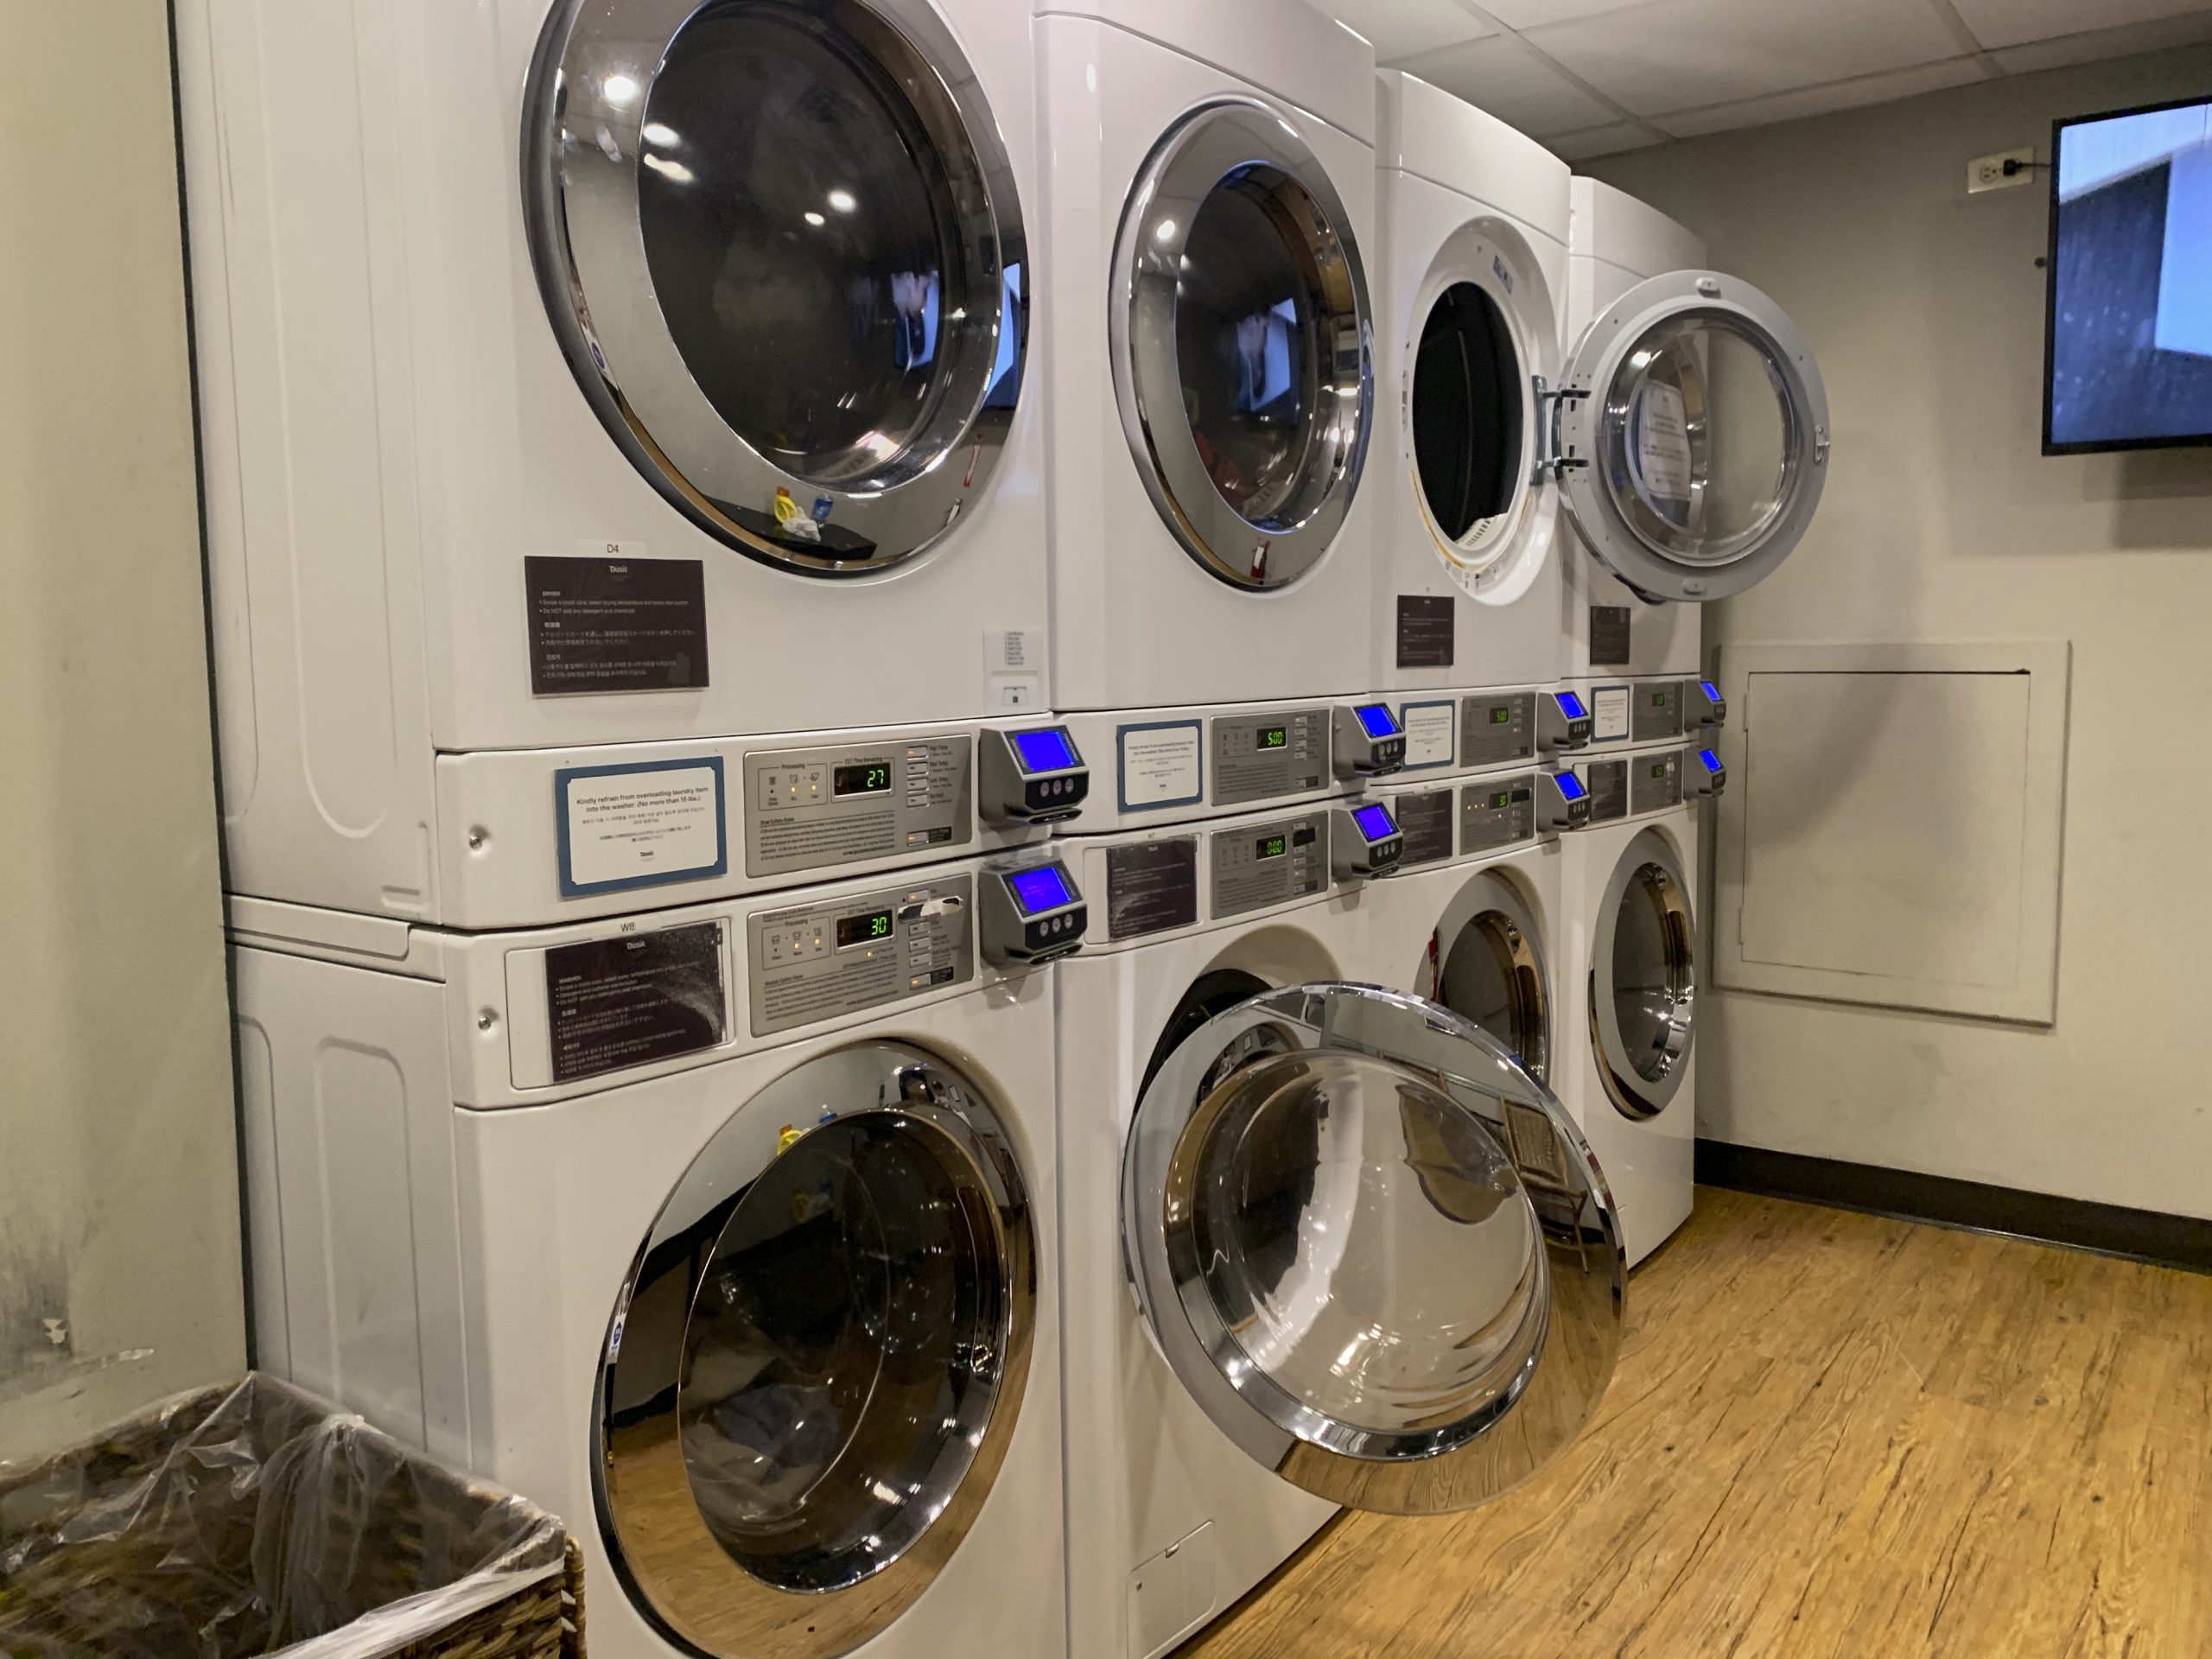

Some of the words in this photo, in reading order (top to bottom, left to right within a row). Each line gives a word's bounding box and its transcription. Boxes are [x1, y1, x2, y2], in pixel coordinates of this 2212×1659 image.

[607, 543, 620, 554] D4
[868, 769, 884, 788] 27
[636, 790, 671, 799] overloading
[620, 921, 635, 932] W8
[871, 916, 888, 936] 30
